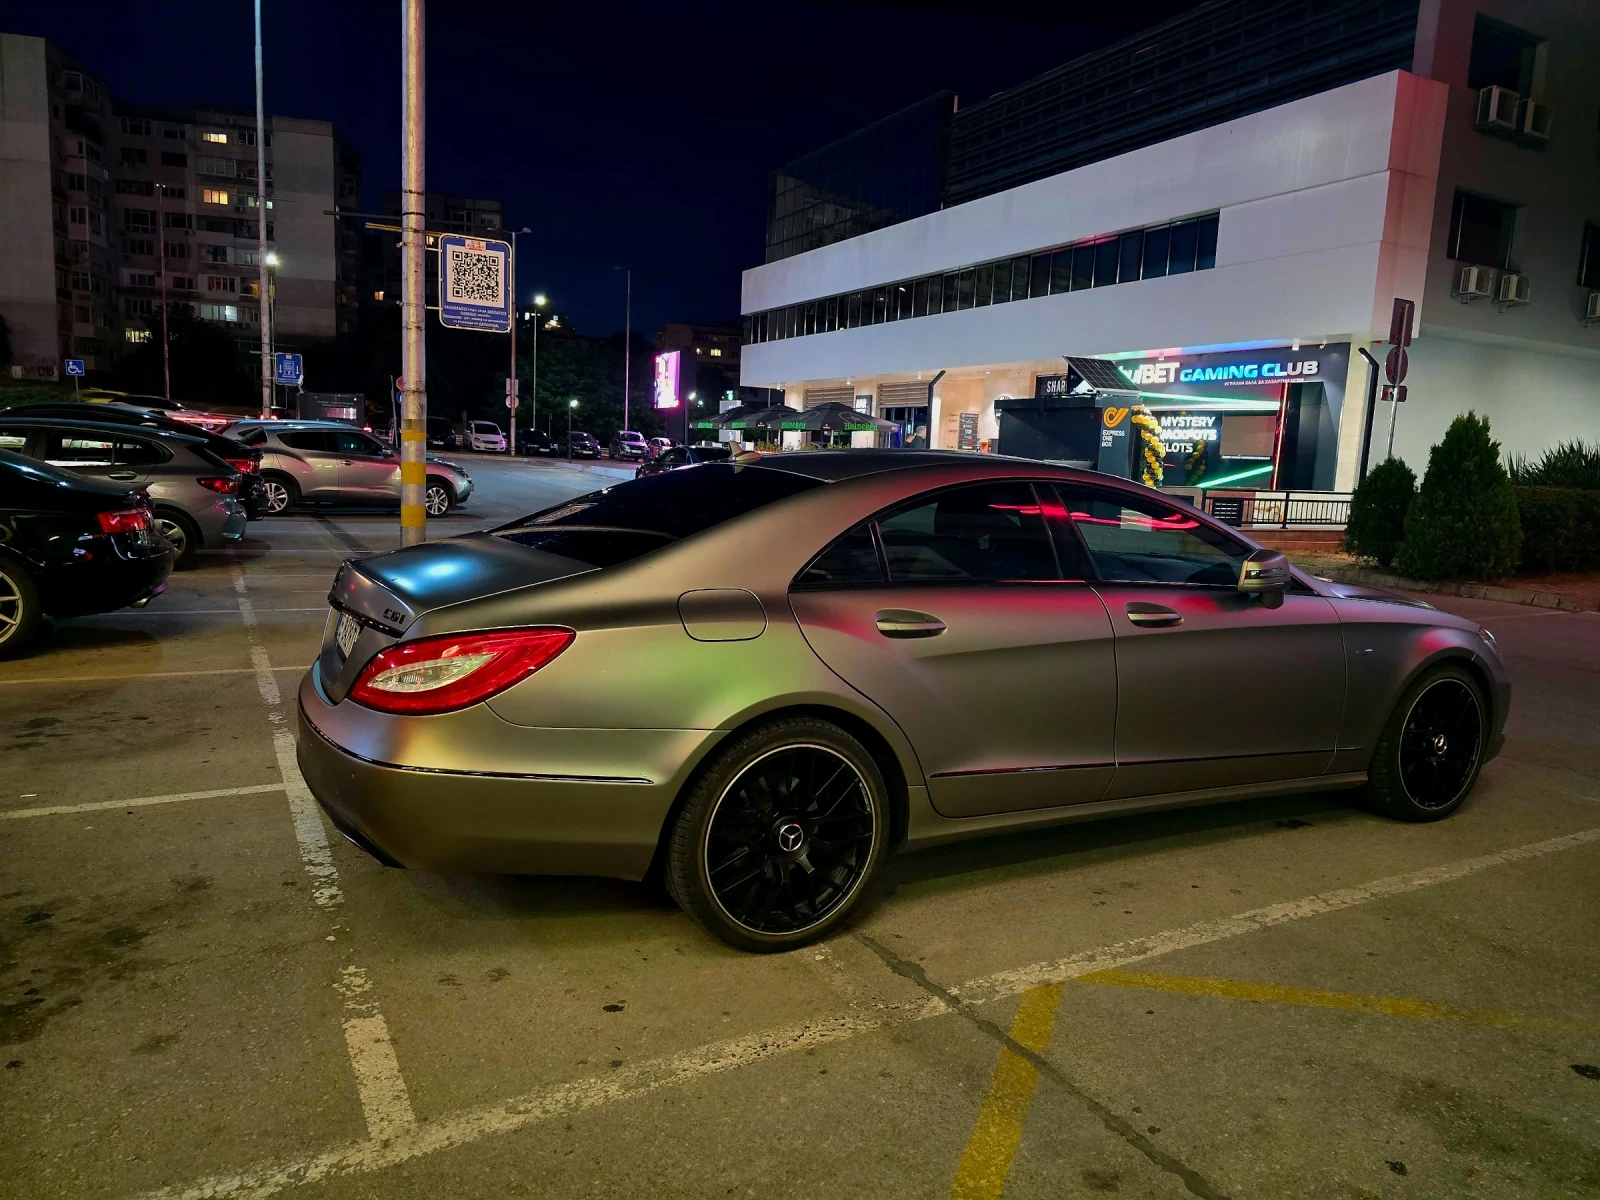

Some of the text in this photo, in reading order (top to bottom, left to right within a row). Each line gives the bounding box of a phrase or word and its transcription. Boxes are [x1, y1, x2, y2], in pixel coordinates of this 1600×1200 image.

[1180, 365, 1258, 382] GAMING
[1261, 361, 1318, 376] CLUB
[1046, 380, 1067, 393] SHAR
[844, 422, 878, 431] Heineken
[1160, 416, 1216, 428] MYSTERY
